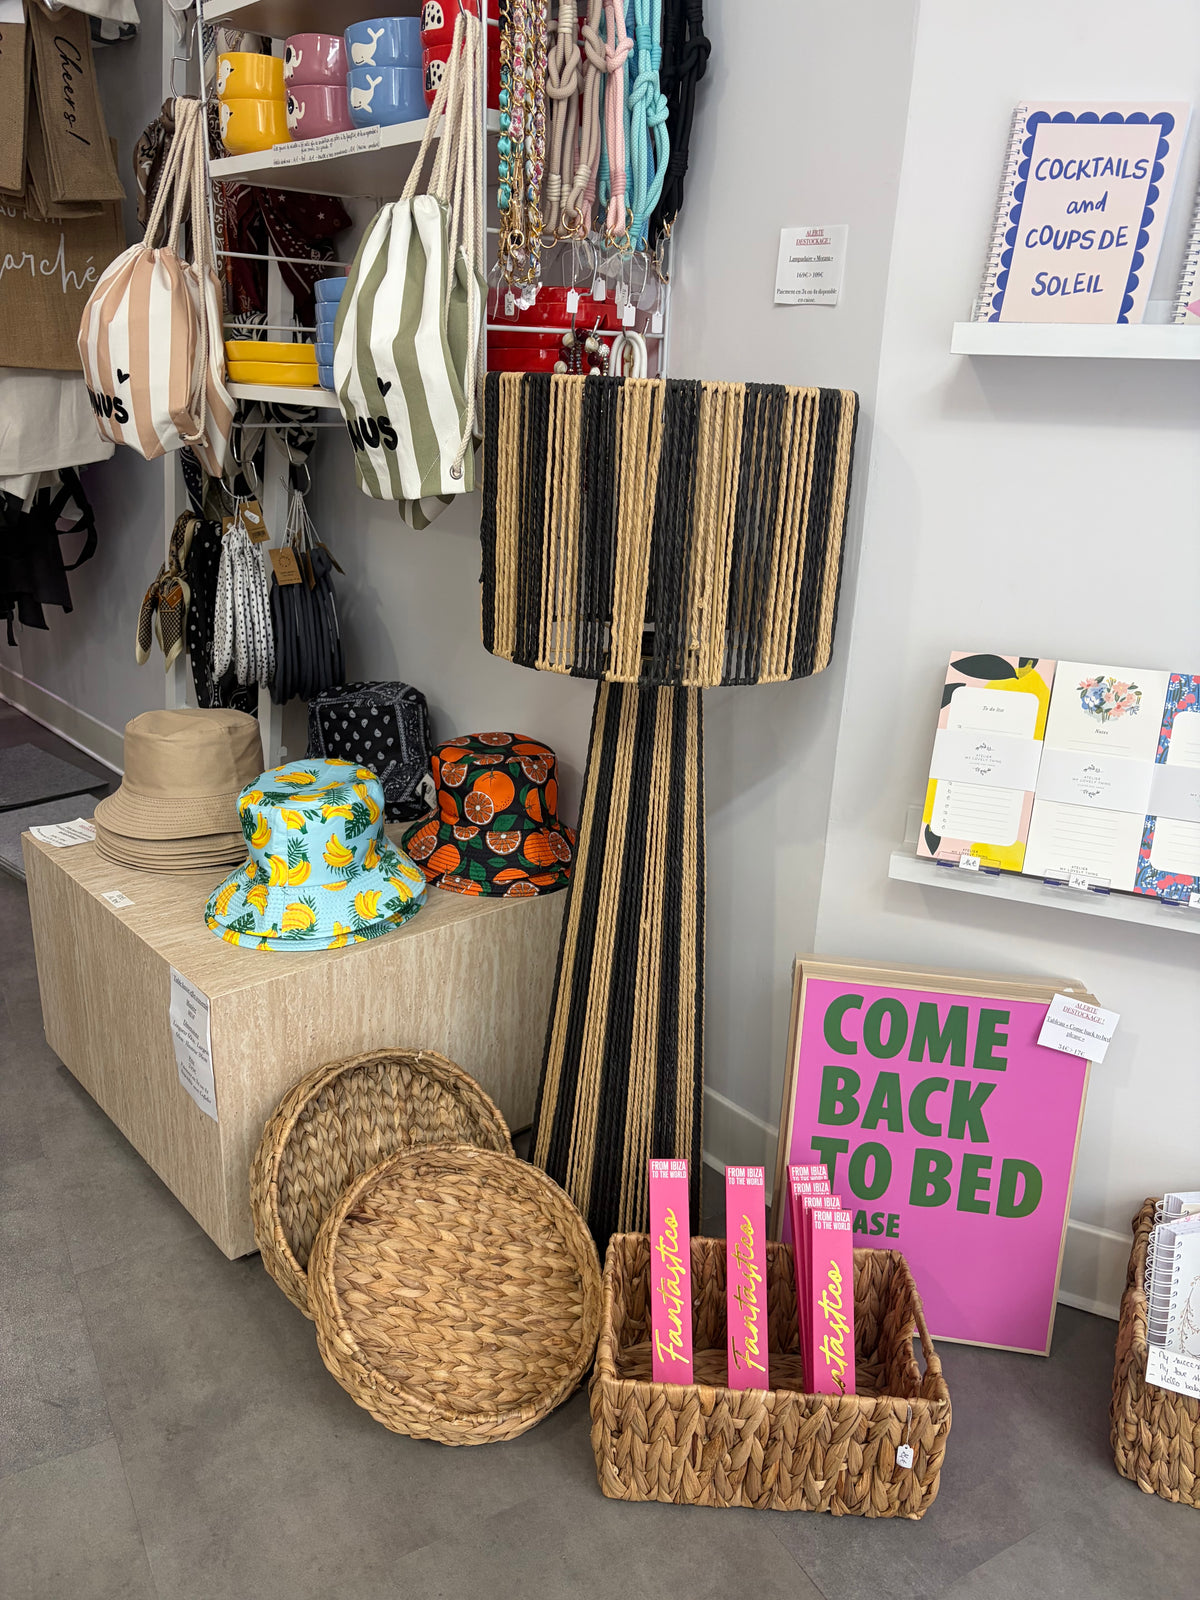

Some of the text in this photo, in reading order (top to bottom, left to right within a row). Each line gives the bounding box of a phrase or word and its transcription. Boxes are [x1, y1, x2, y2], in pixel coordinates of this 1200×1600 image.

[54, 35, 91, 146] Cheers!
[1035, 156, 1150, 181] COCKTAILS
[1066, 190, 1108, 215] and
[805, 229, 825, 238] ALERTE
[1025, 224, 1129, 251] COUPS DE
[0, 232, 99, 294] arché
[1031, 271, 1104, 297] SOLEIL
[86, 384, 129, 424] NUS
[1062, 1005, 1102, 1025] DESTOCKAGE
[1075, 1002, 1098, 1015] ALERTE
[823, 993, 1011, 1072] COME
[817, 1065, 998, 1143] BACK
[651, 1161, 686, 1171] FROM IBIZA
[652, 1170, 687, 1179] TO THE WORLD
[727, 1167, 763, 1178] FROM IBIZA
[791, 1166, 828, 1177] FROM IBIZA
[810, 1135, 1043, 1219] TO BED
[728, 1177, 764, 1186] TO THE WORLD
[793, 1182, 829, 1193] FROM IBIZA
[804, 1196, 841, 1207] FROM IBIZA
[813, 1210, 851, 1222] FROM IBIZA
[814, 1221, 851, 1231] TO THE WORLD
[852, 1209, 900, 1239] ASE
[655, 1207, 690, 1364] Fantastico
[731, 1214, 766, 1372] Fantastico
[818, 1260, 851, 1396] ntastico
[1172, 1356, 1200, 1371] succes
[1184, 1381, 1200, 1393] bab
